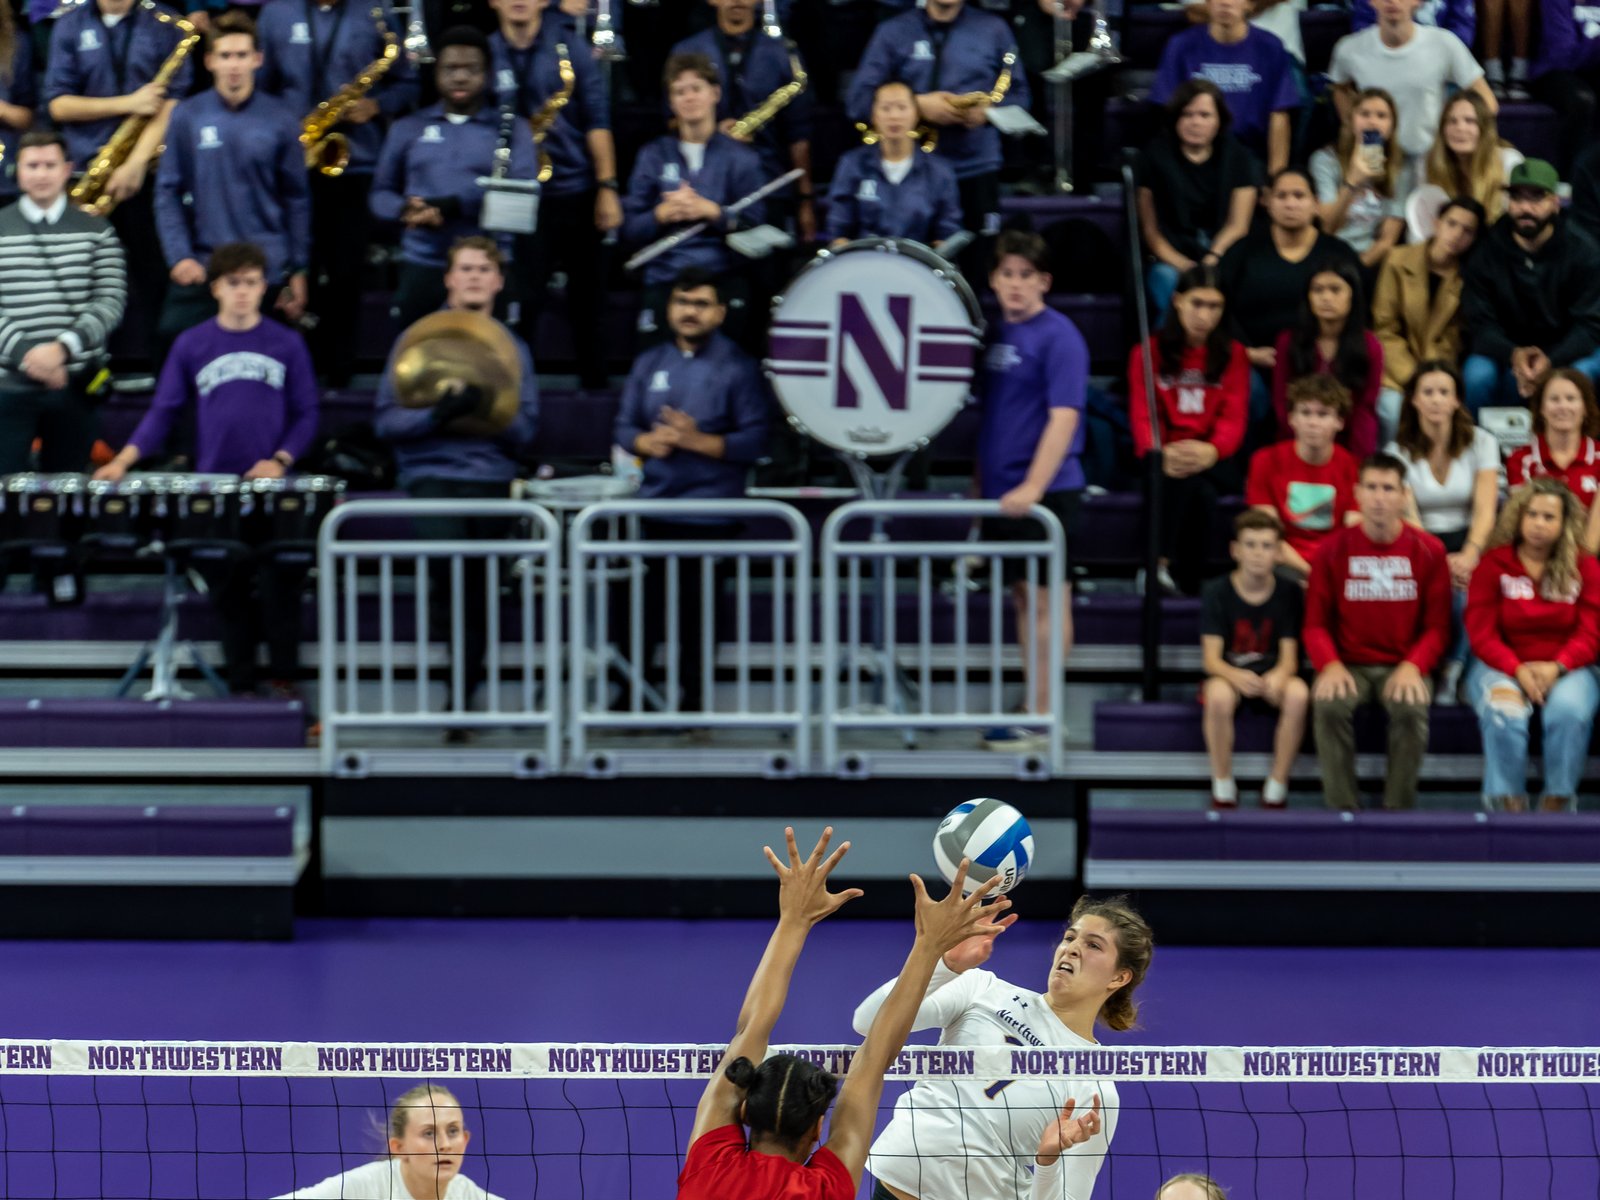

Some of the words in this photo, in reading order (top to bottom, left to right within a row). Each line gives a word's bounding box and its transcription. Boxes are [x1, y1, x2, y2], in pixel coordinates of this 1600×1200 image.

[836, 292, 912, 410] N
[88, 1046, 282, 1070] NORTHWESTERN
[317, 1047, 511, 1072] NORTHWESTERN
[1010, 1050, 1207, 1076] NORTHWESTERN
[1243, 1052, 1440, 1077] NORTHWESTERN
[1477, 1052, 1600, 1077] NORTHWE
